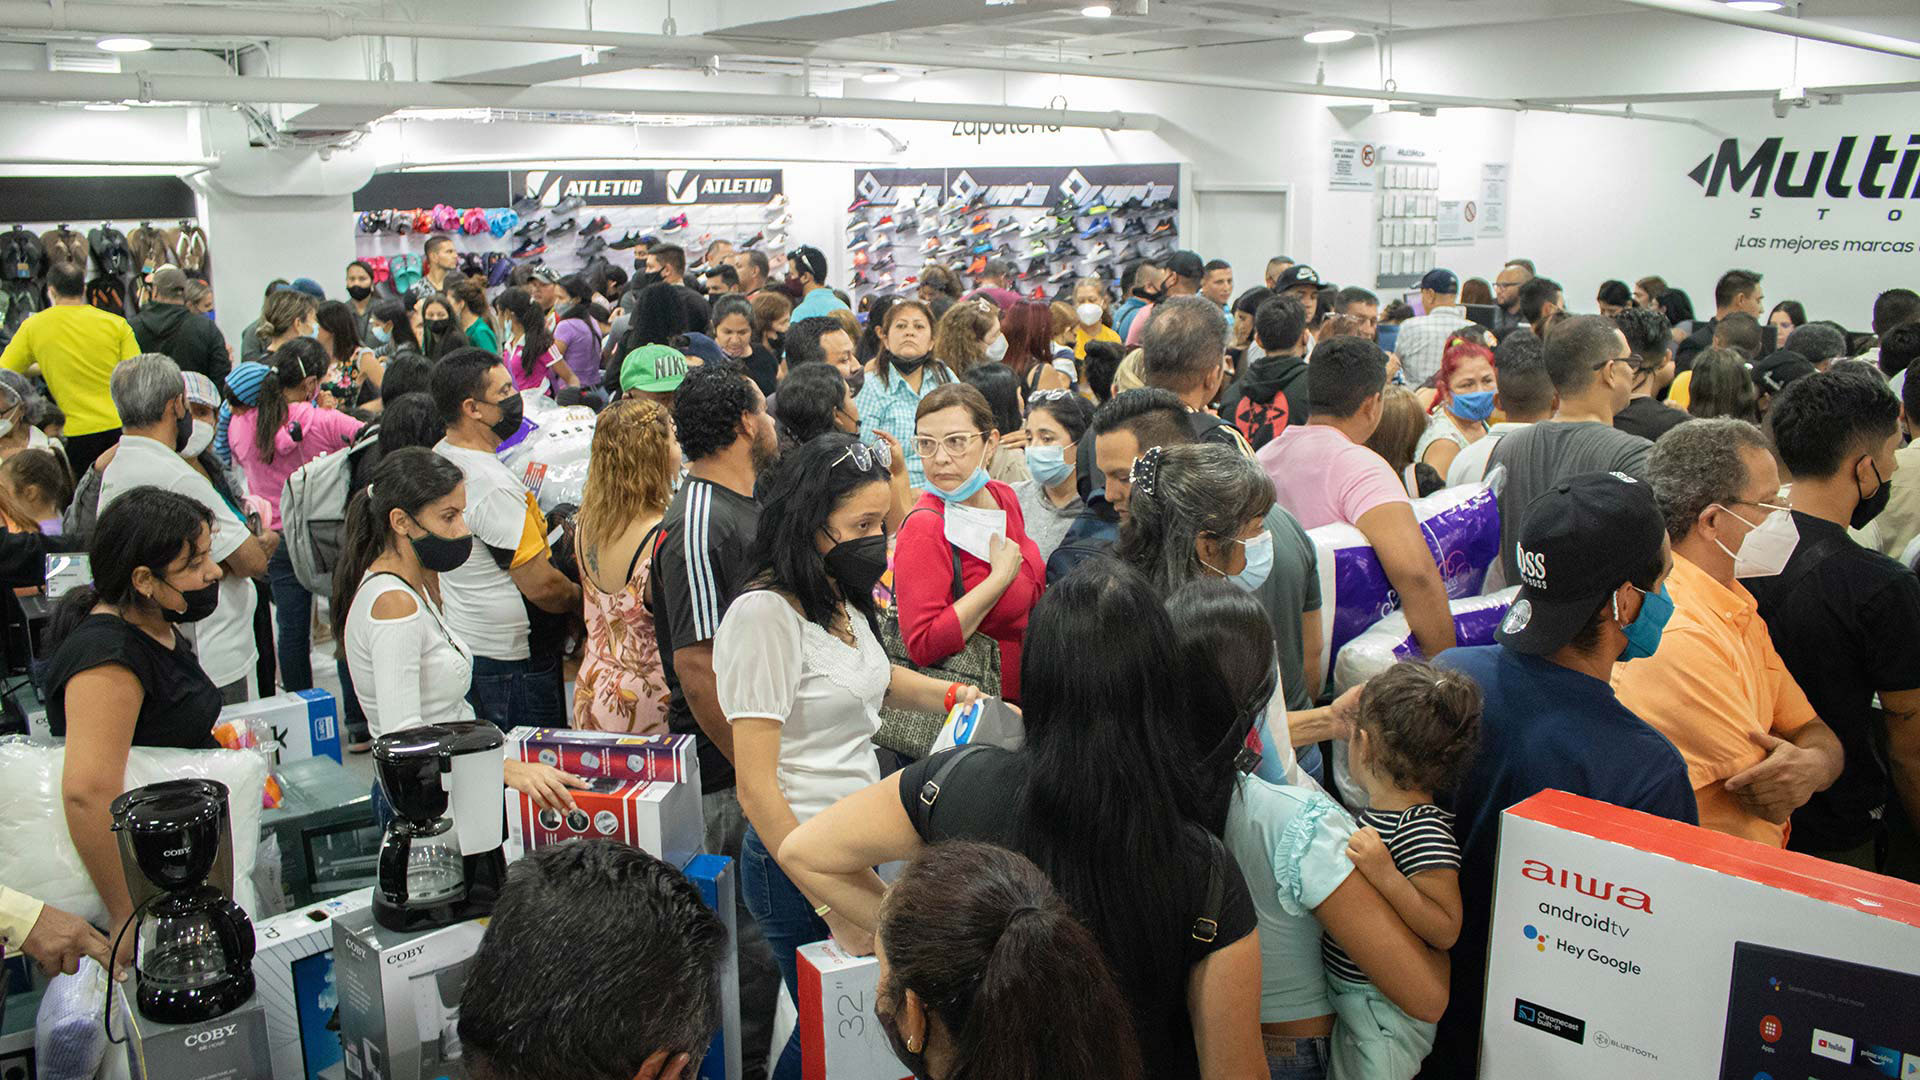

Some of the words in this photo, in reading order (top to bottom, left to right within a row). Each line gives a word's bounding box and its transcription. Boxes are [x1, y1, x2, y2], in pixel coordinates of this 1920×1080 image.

[1705, 134, 1920, 199] Multi
[1735, 235, 1766, 251] ¡Las
[1770, 235, 1839, 254] mejores
[1843, 239, 1914, 253] marcas
[163, 846, 191, 857] COBY
[1521, 859, 1654, 914] aiwa
[387, 945, 425, 965] COBY
[1557, 938, 1584, 959] Hey
[1587, 948, 1641, 975] Google
[1537, 1011, 1579, 1031] Chromecast
[184, 1023, 237, 1047] COBY
[1610, 1040, 1658, 1060] BLUETOOTH
